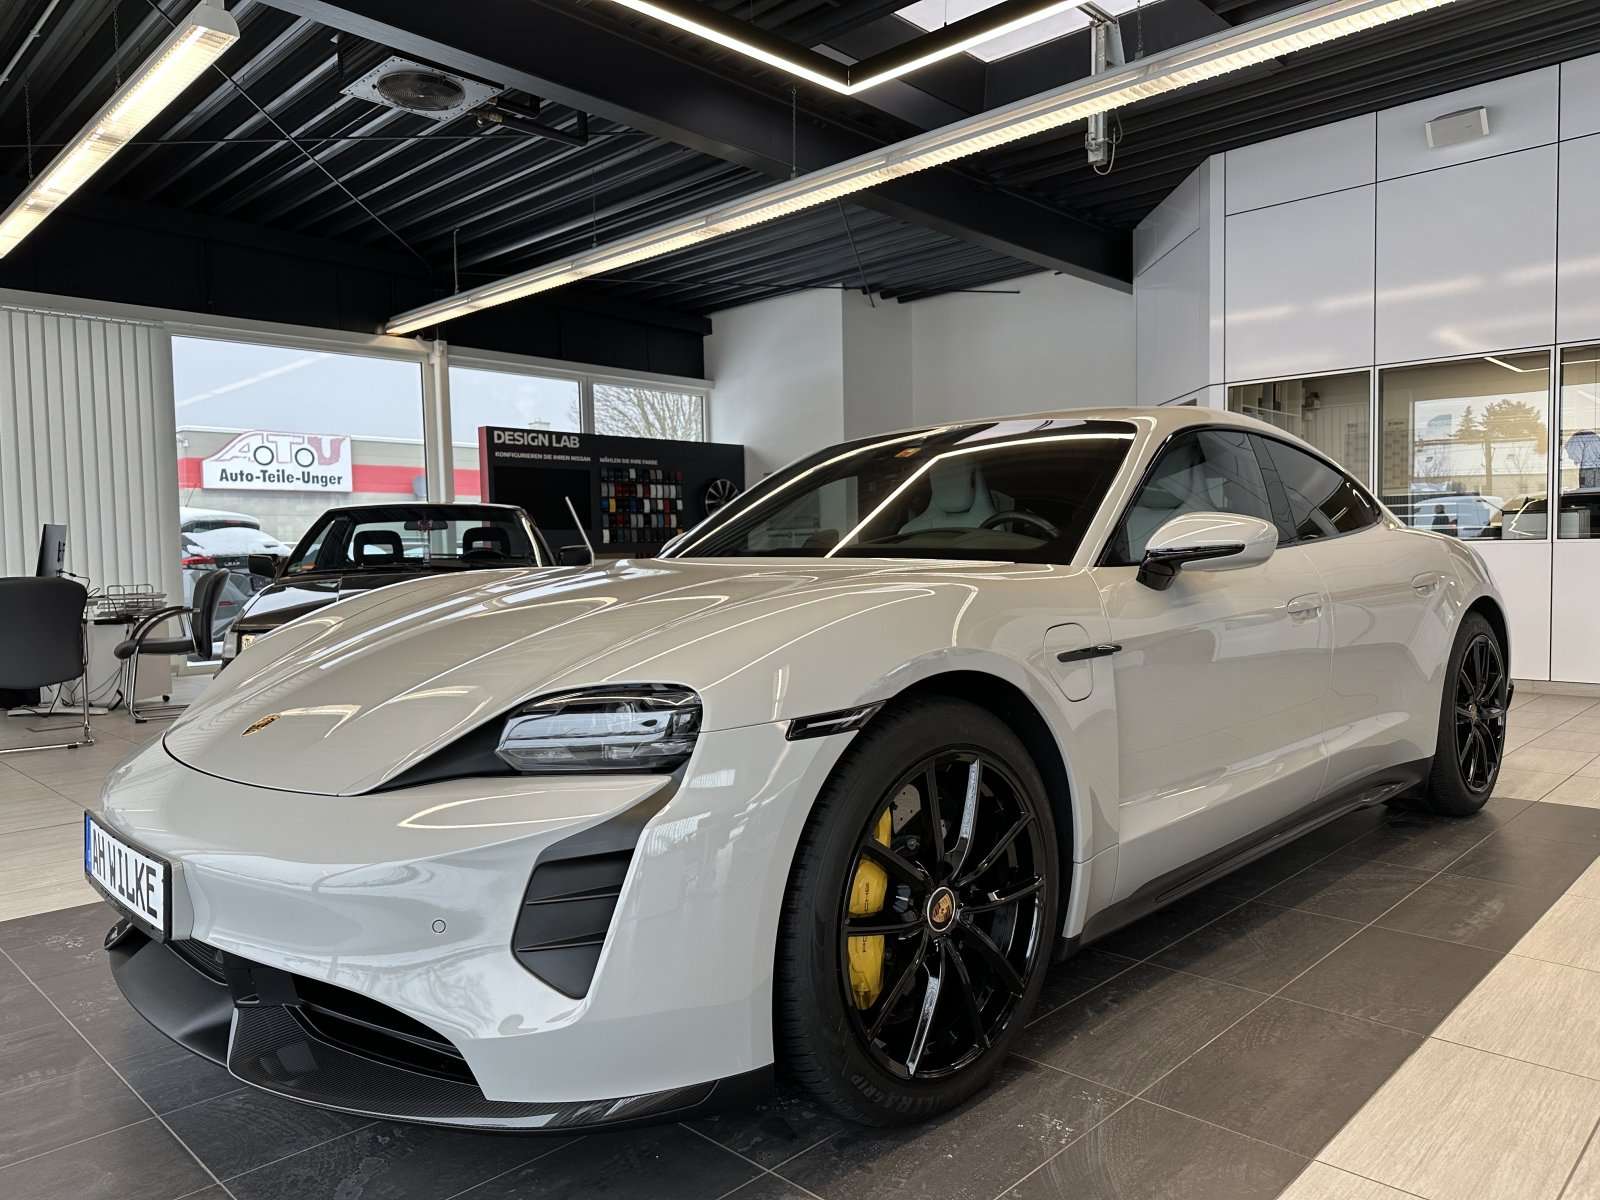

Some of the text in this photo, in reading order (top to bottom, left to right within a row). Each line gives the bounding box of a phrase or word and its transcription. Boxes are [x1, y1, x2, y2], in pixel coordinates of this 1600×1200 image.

[493, 430, 580, 448] DESIGN LAB
[219, 468, 343, 487] Auto-Teile-Unger
[107, 839, 158, 919] WILKE
